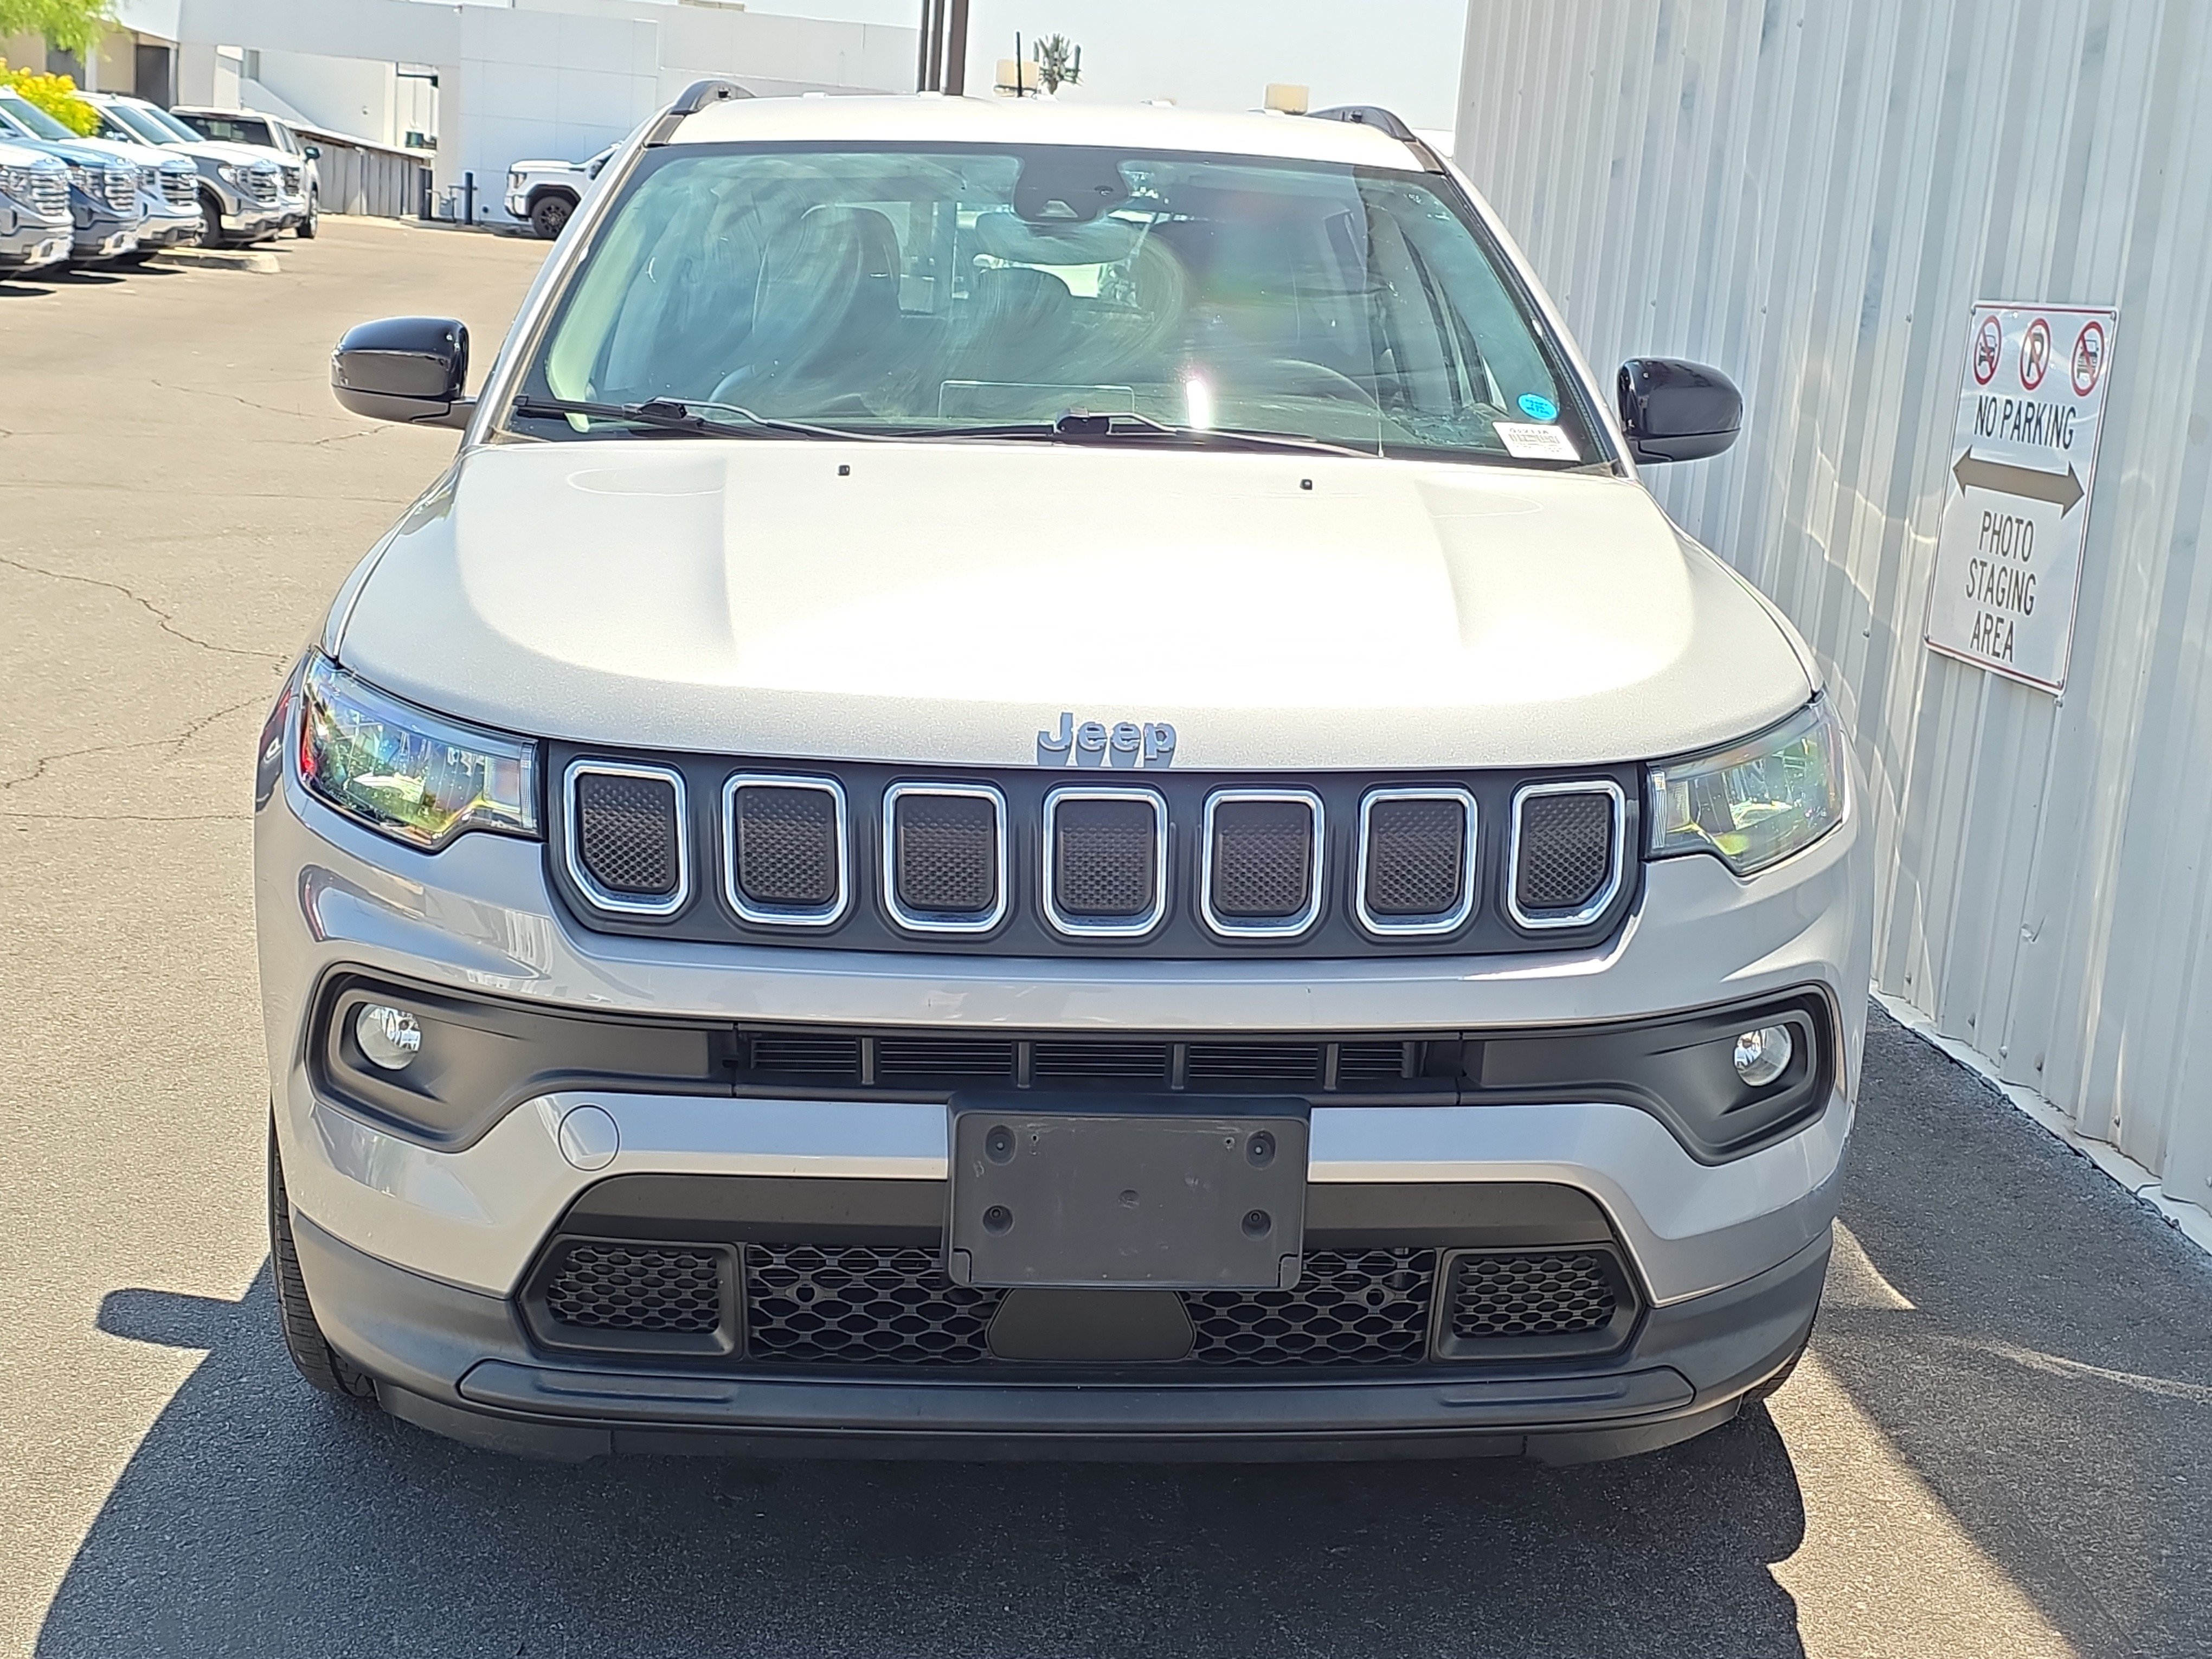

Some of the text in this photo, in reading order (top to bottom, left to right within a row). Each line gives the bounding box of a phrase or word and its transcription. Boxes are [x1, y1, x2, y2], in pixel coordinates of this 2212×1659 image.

[1974, 395, 2076, 450] NO PARKING
[1978, 510, 2034, 562] PHOTO
[1966, 557, 2036, 616] STAGING
[1970, 610, 2014, 663] AREA
[1038, 712, 1176, 760] Jeep
